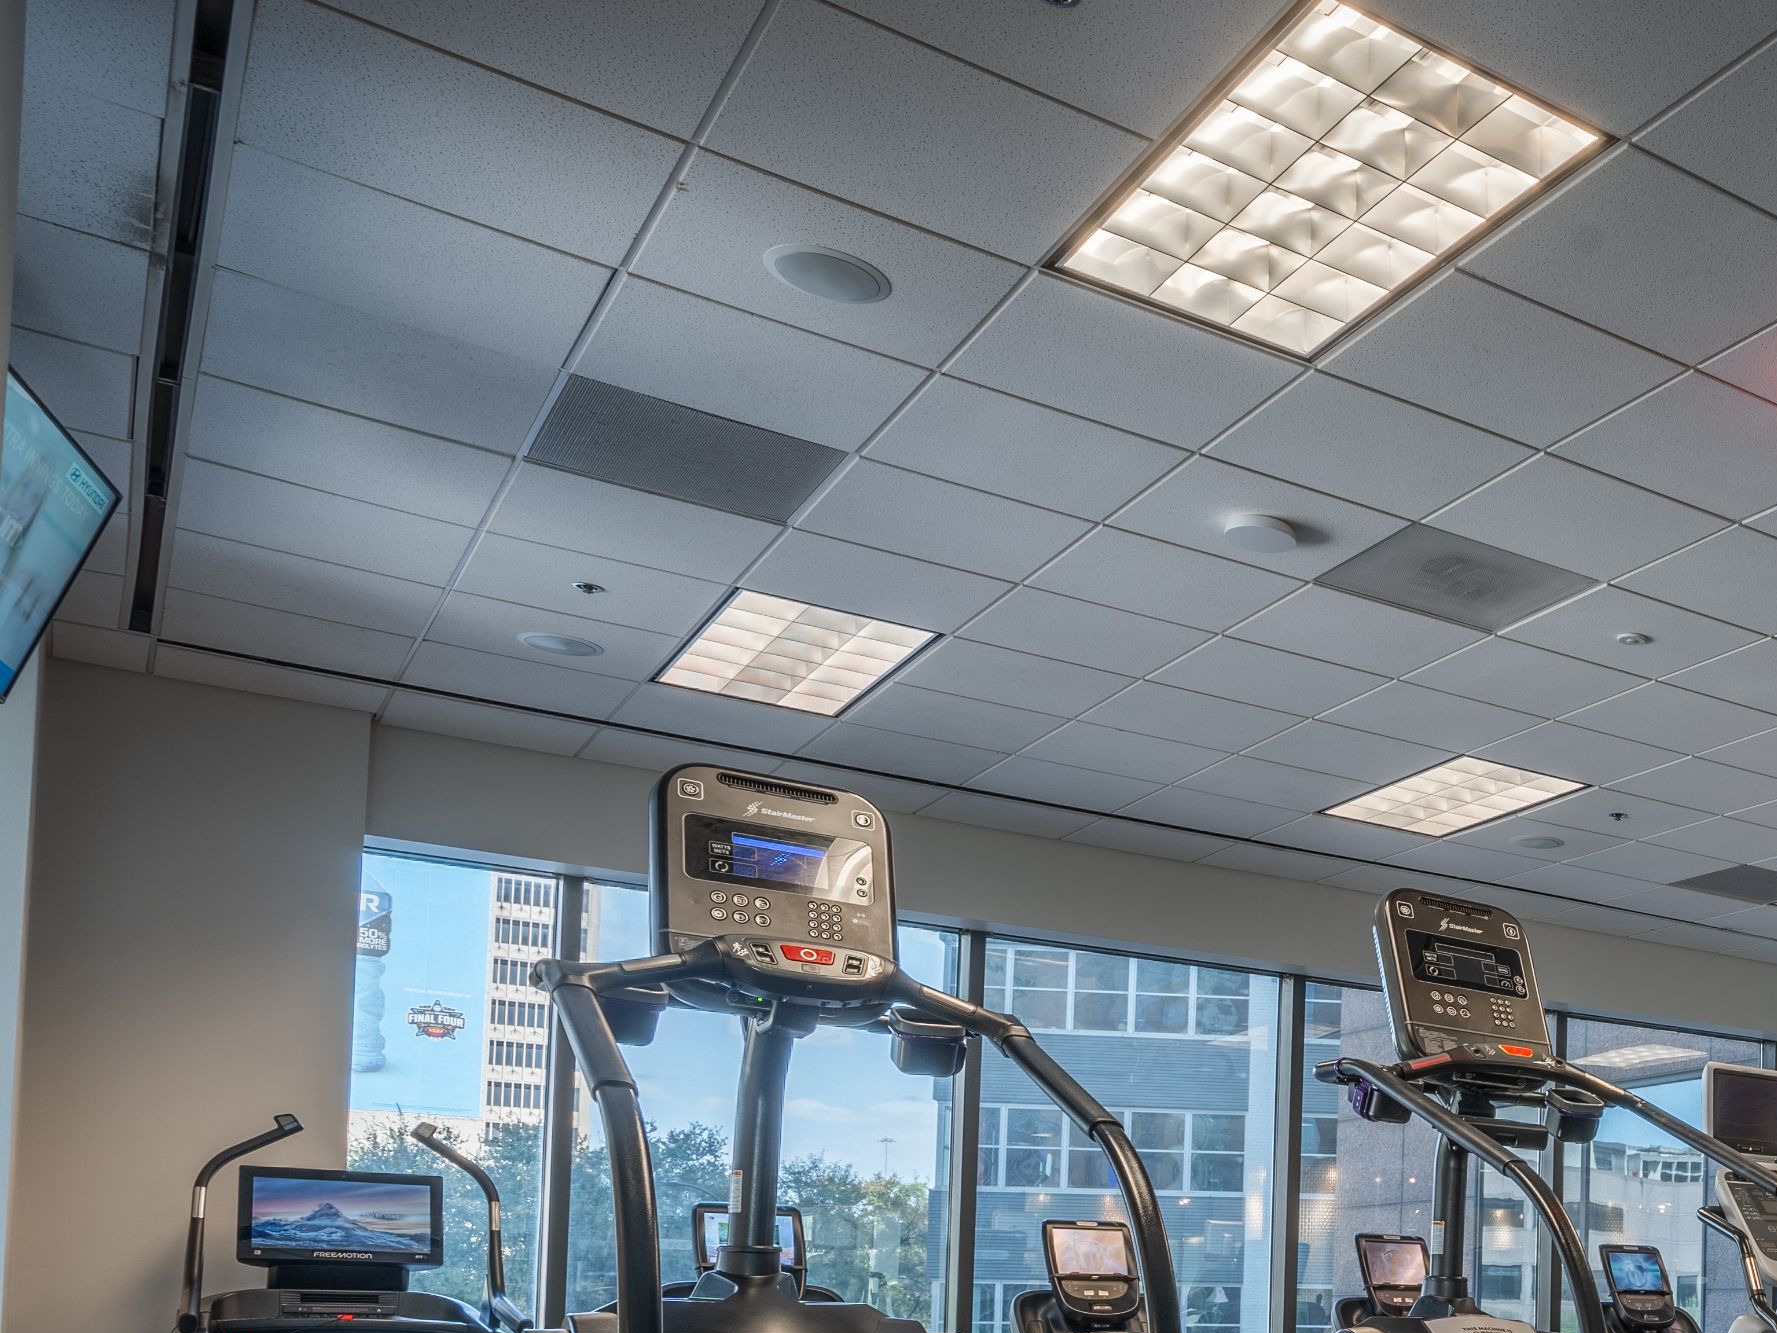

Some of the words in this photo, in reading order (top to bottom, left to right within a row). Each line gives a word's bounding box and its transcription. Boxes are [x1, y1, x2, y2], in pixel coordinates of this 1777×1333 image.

[760, 807, 817, 822] StairMaster
[1448, 923, 1484, 934] StairMaster
[408, 1013, 436, 1024] FINAL
[437, 1015, 465, 1028] FOUR
[313, 1251, 373, 1260] FREEMOTION
